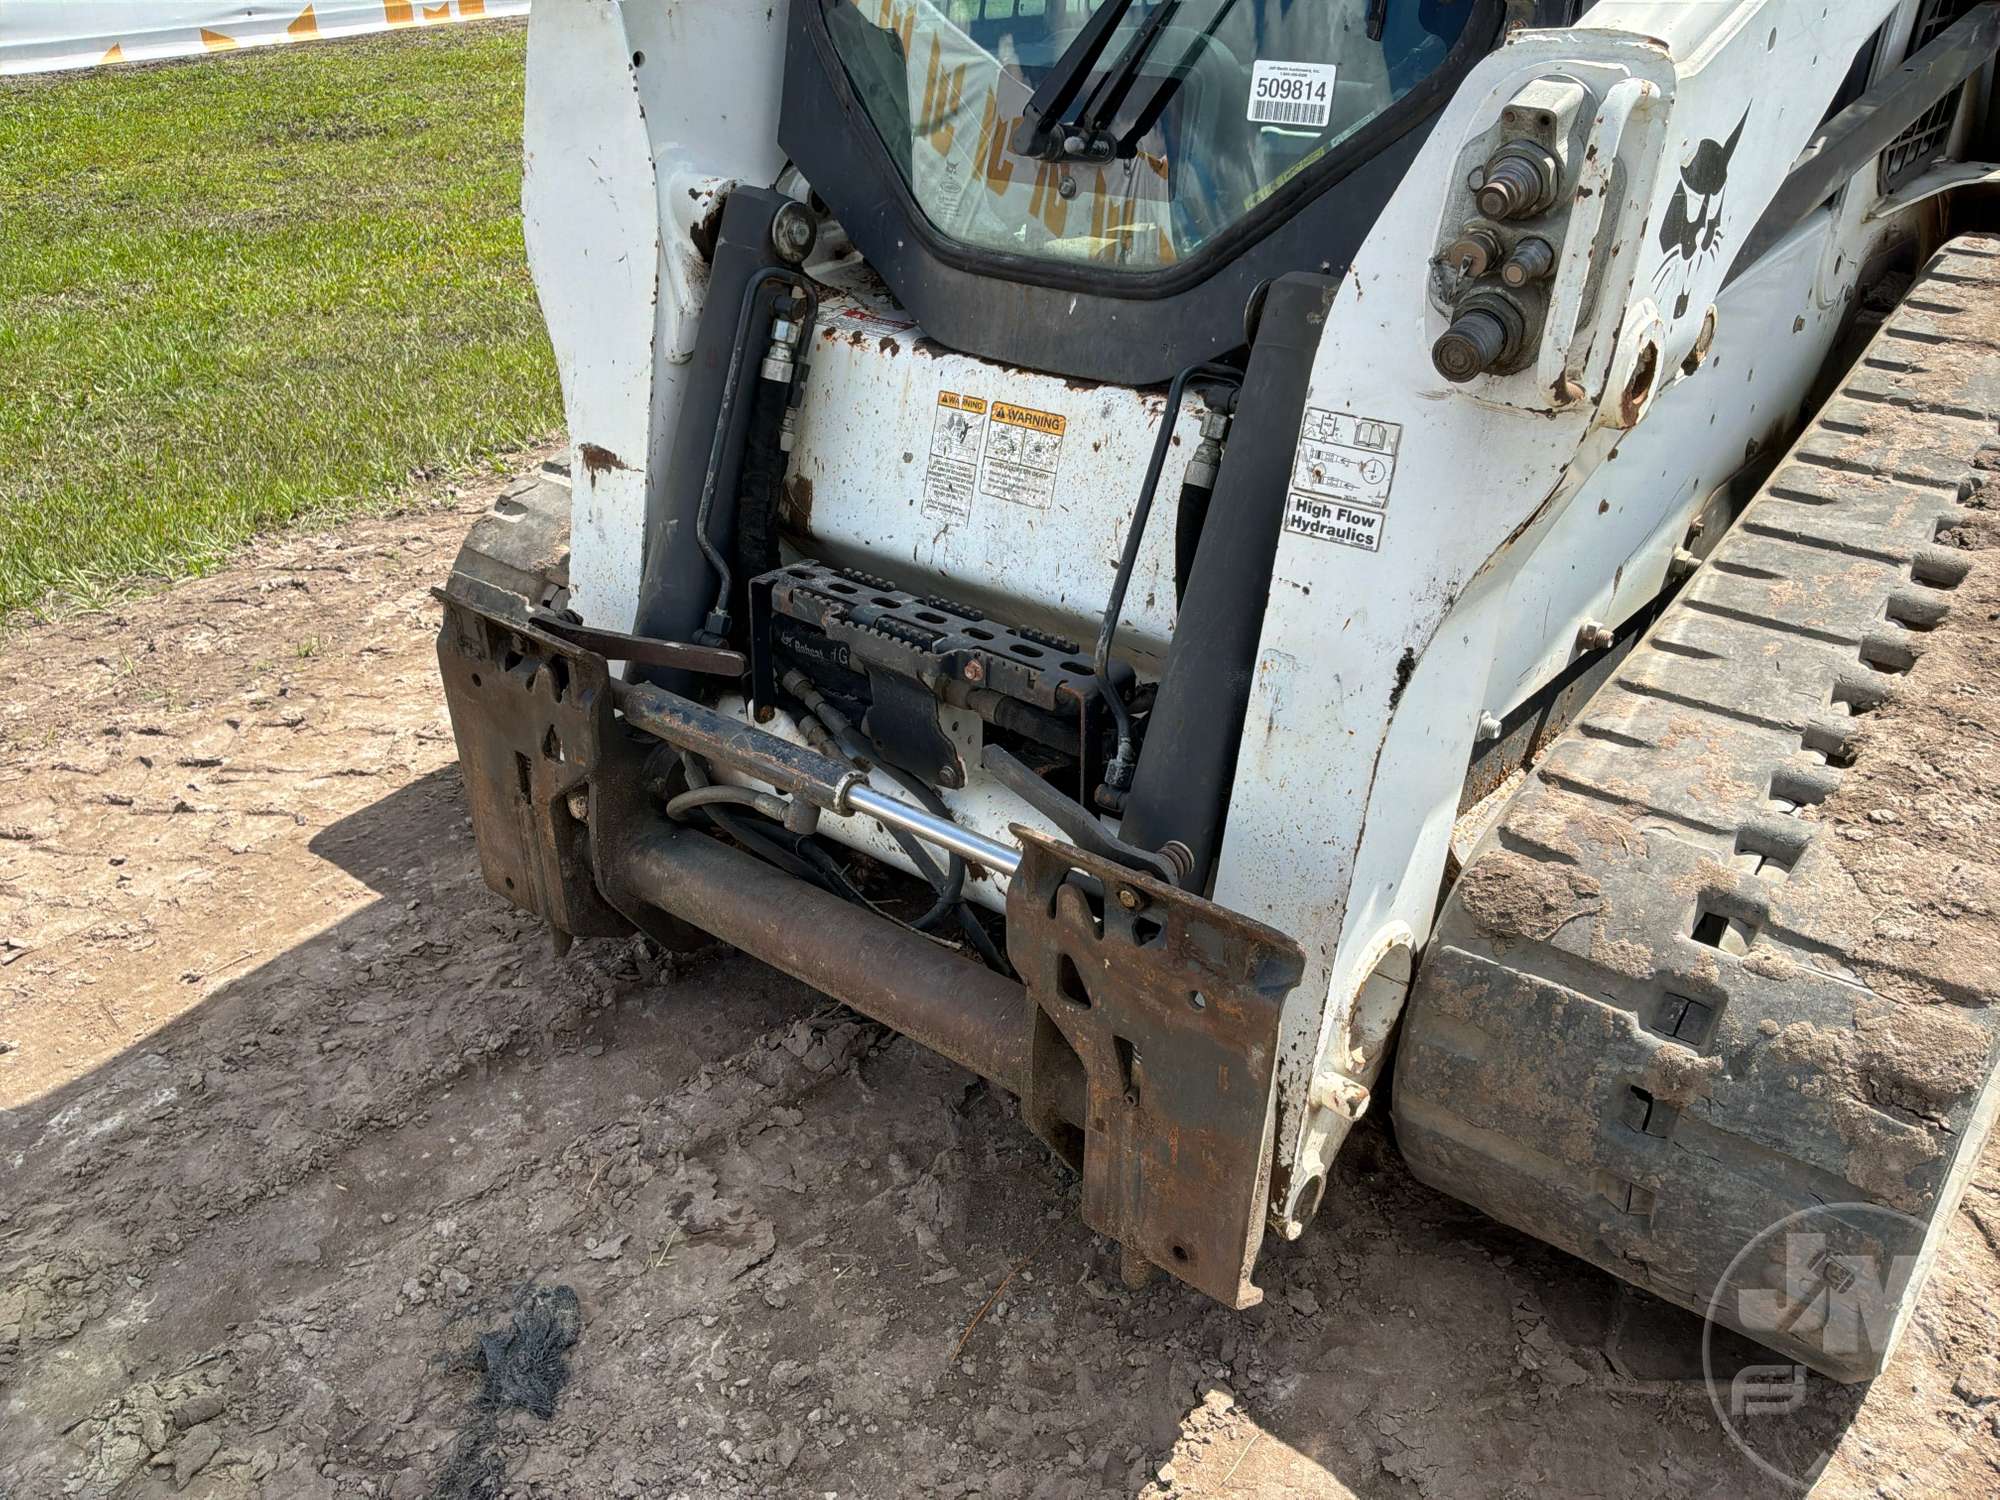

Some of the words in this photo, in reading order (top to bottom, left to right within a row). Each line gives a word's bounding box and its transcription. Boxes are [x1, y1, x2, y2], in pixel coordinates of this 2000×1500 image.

[1256, 77, 1327, 102] 509814
[948, 397, 983, 411] WARNING
[1008, 410, 1061, 430] WARNING
[1295, 498, 1331, 519] High
[1336, 508, 1376, 528] Flow
[1290, 514, 1375, 545] Hydraulics
